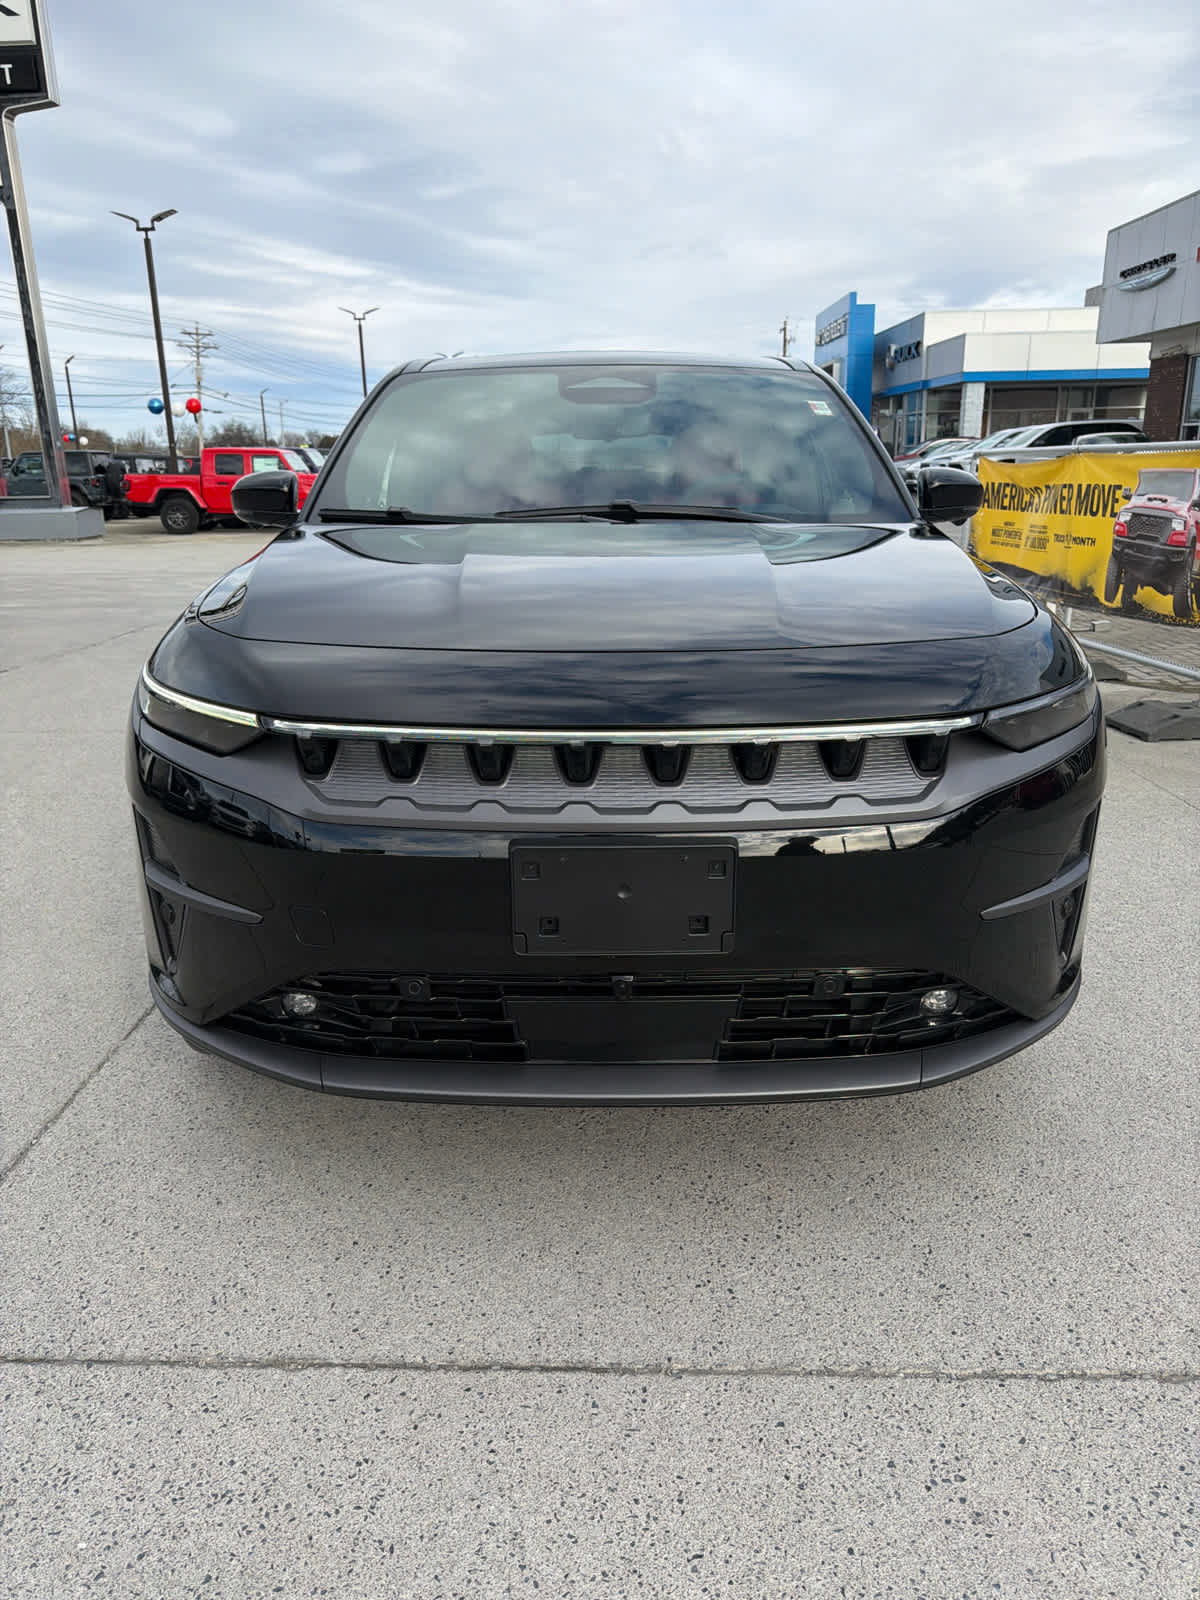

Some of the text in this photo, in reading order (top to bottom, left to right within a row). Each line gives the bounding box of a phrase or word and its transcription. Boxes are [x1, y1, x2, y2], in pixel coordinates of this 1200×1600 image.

[1041, 483, 1074, 515] PWER
[1074, 483, 1123, 518] MOVE
[1072, 536, 1096, 547] MONTH
